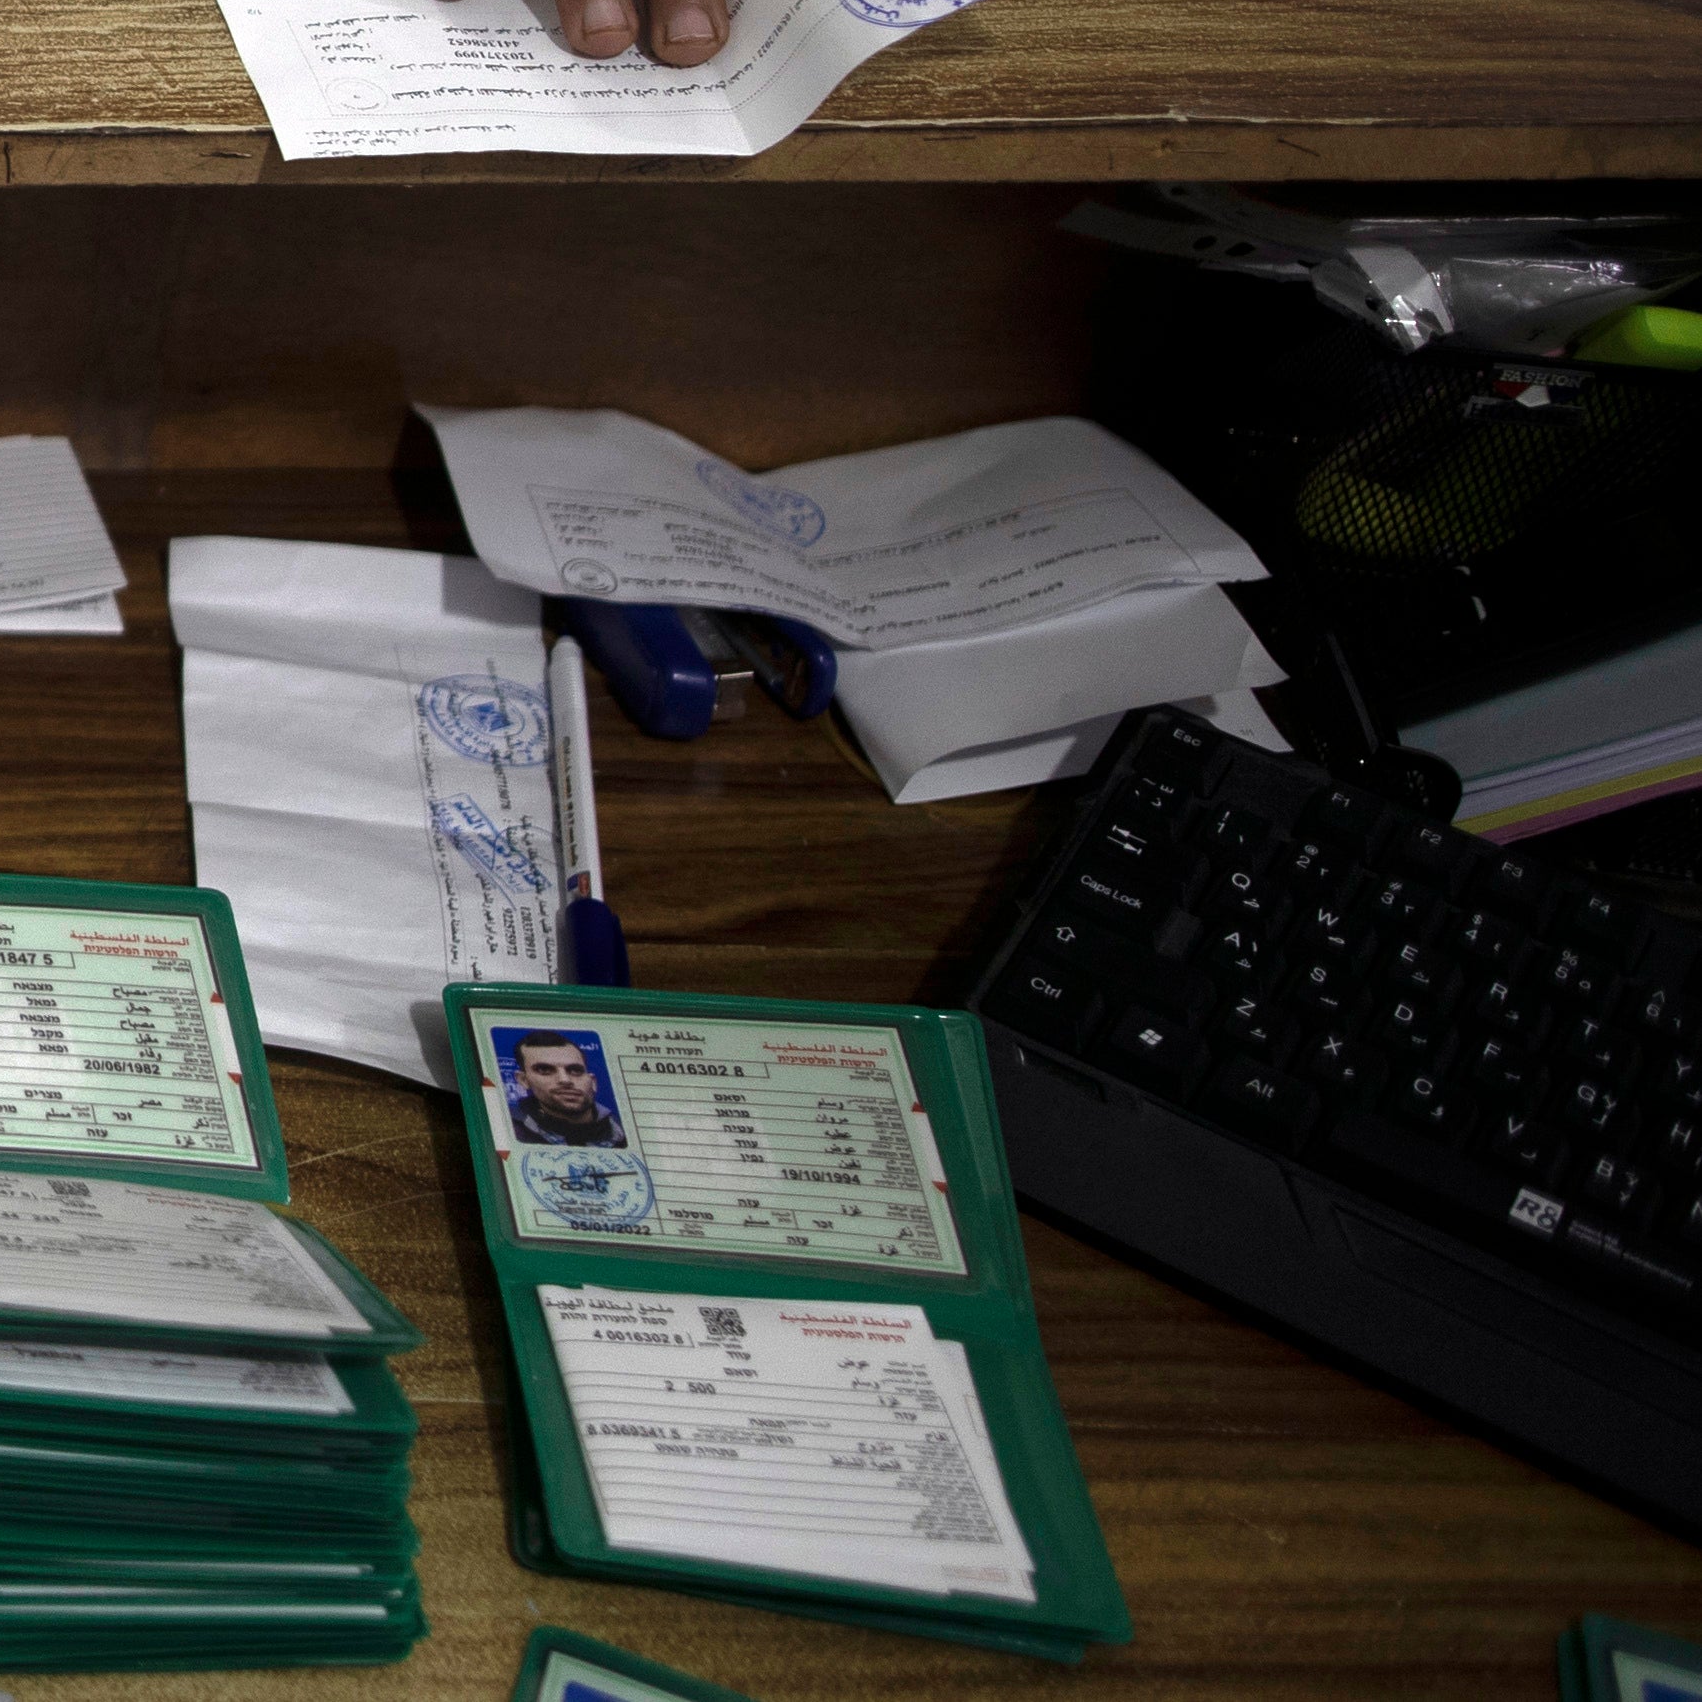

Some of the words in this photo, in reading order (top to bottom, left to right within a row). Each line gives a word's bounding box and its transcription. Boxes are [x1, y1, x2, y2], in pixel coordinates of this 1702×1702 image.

[1173, 728, 1202, 747] Esc
[1331, 792, 1351, 807] F1
[1420, 827, 1442, 845] F2
[1501, 860, 1523, 879] F3
[1080, 874, 1111, 895] Caps
[1112, 887, 1142, 909] Lock
[1589, 898, 1611, 915] F4
[70, 930, 140, 944] الفلسطينية
[144, 933, 189, 946] السلطة
[83, 944, 140, 956] הפלסטינית
[43, 954, 54, 966] 5
[13, 981, 54, 991] מצבאח
[1030, 977, 1063, 999] Ctrl
[26, 997, 57, 1007] גמאל
[19, 1012, 60, 1023] מצבאח
[30, 1027, 64, 1039] מקבל
[628, 1029, 660, 1040] هوية
[664, 1031, 705, 1045] بطاقة
[635, 1045, 663, 1055] זהות
[667, 1045, 703, 1056] תעודת
[763, 1041, 837, 1055] الفلسطينية
[841, 1044, 887, 1057] السلطة
[84, 1058, 160, 1075] 20/06/1982
[777, 1054, 836, 1066] הפלסטינית
[640, 1061, 651, 1074] 4
[656, 1063, 727, 1077] 0016302
[734, 1065, 744, 1077] 8
[24, 1088, 63, 1099] מצרים
[1246, 1078, 1276, 1099] Alt
[113, 1111, 132, 1121] זכר
[781, 1168, 861, 1185] 19/10/1994
